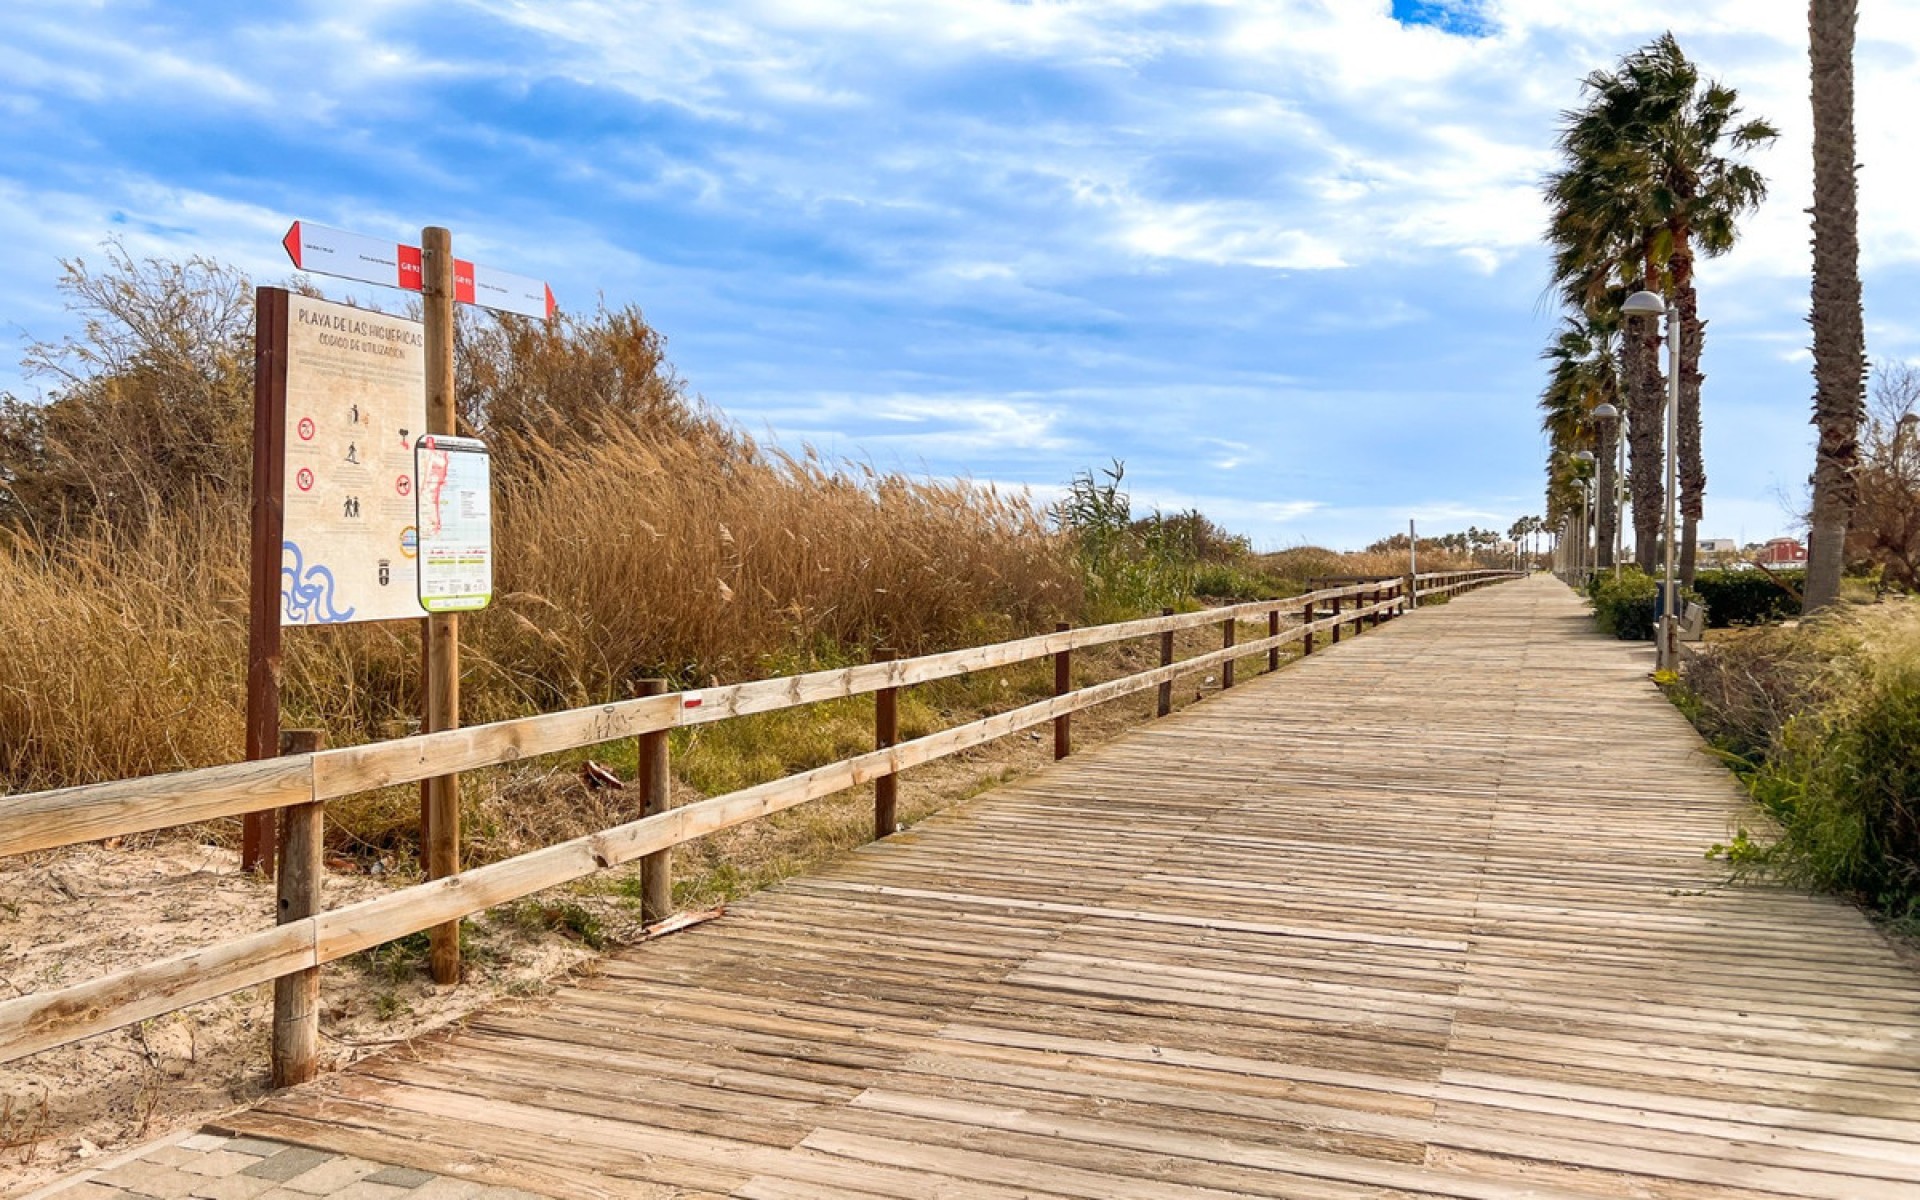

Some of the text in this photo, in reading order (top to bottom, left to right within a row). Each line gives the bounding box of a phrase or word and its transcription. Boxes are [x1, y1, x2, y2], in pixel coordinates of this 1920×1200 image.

[402, 262, 412, 271] GR
[299, 308, 423, 347] PLAYA DE LAS HIGUERICAS
[350, 338, 360, 351] DE
